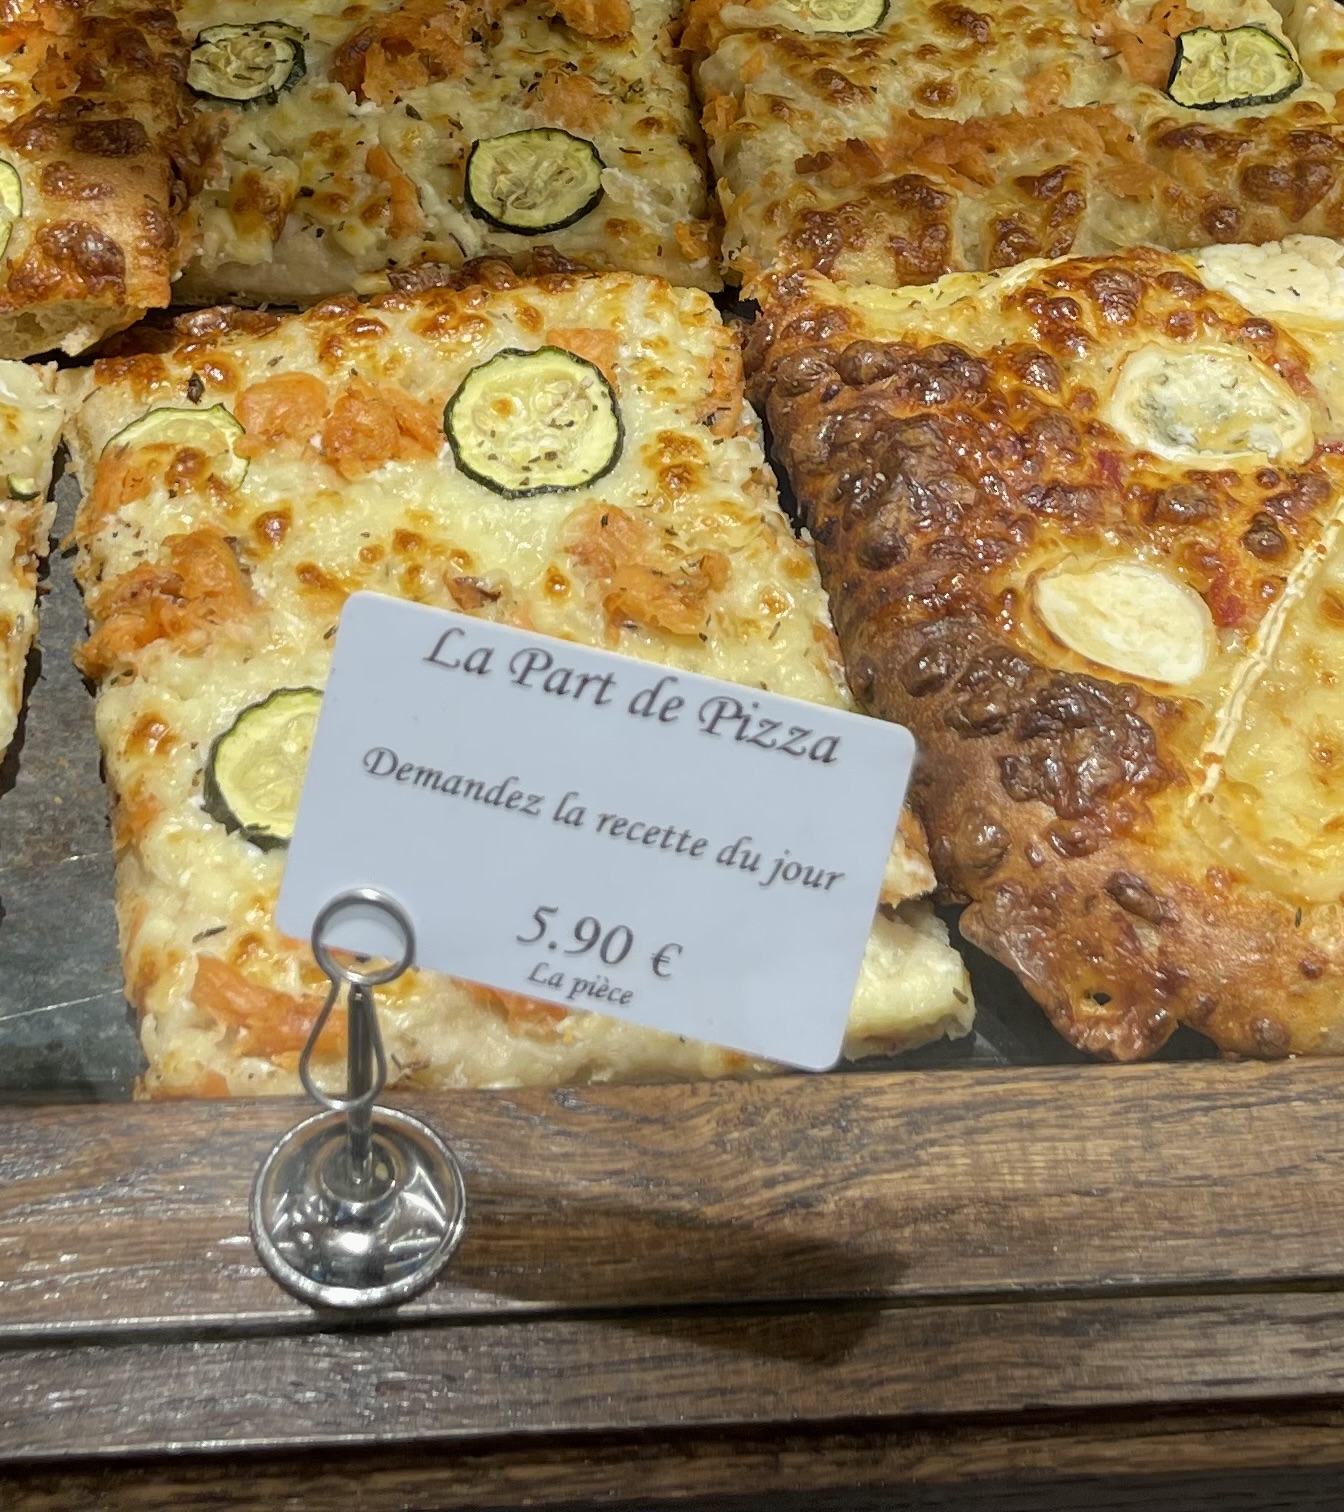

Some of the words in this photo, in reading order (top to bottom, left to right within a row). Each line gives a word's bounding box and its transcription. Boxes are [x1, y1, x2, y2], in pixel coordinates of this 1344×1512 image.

[423, 627, 492, 676] La
[507, 646, 618, 708] Part
[628, 676, 686, 724] de
[698, 694, 843, 766] Pizza
[362, 746, 543, 817] Demandez
[552, 791, 587, 829] la
[596, 813, 709, 860] recette
[716, 835, 761, 875] du
[757, 848, 846, 893] jour
[516, 903, 635, 967] 5.90
[651, 942, 685, 979] €
[527, 961, 567, 988] La
[570, 970, 635, 1007] pièce
